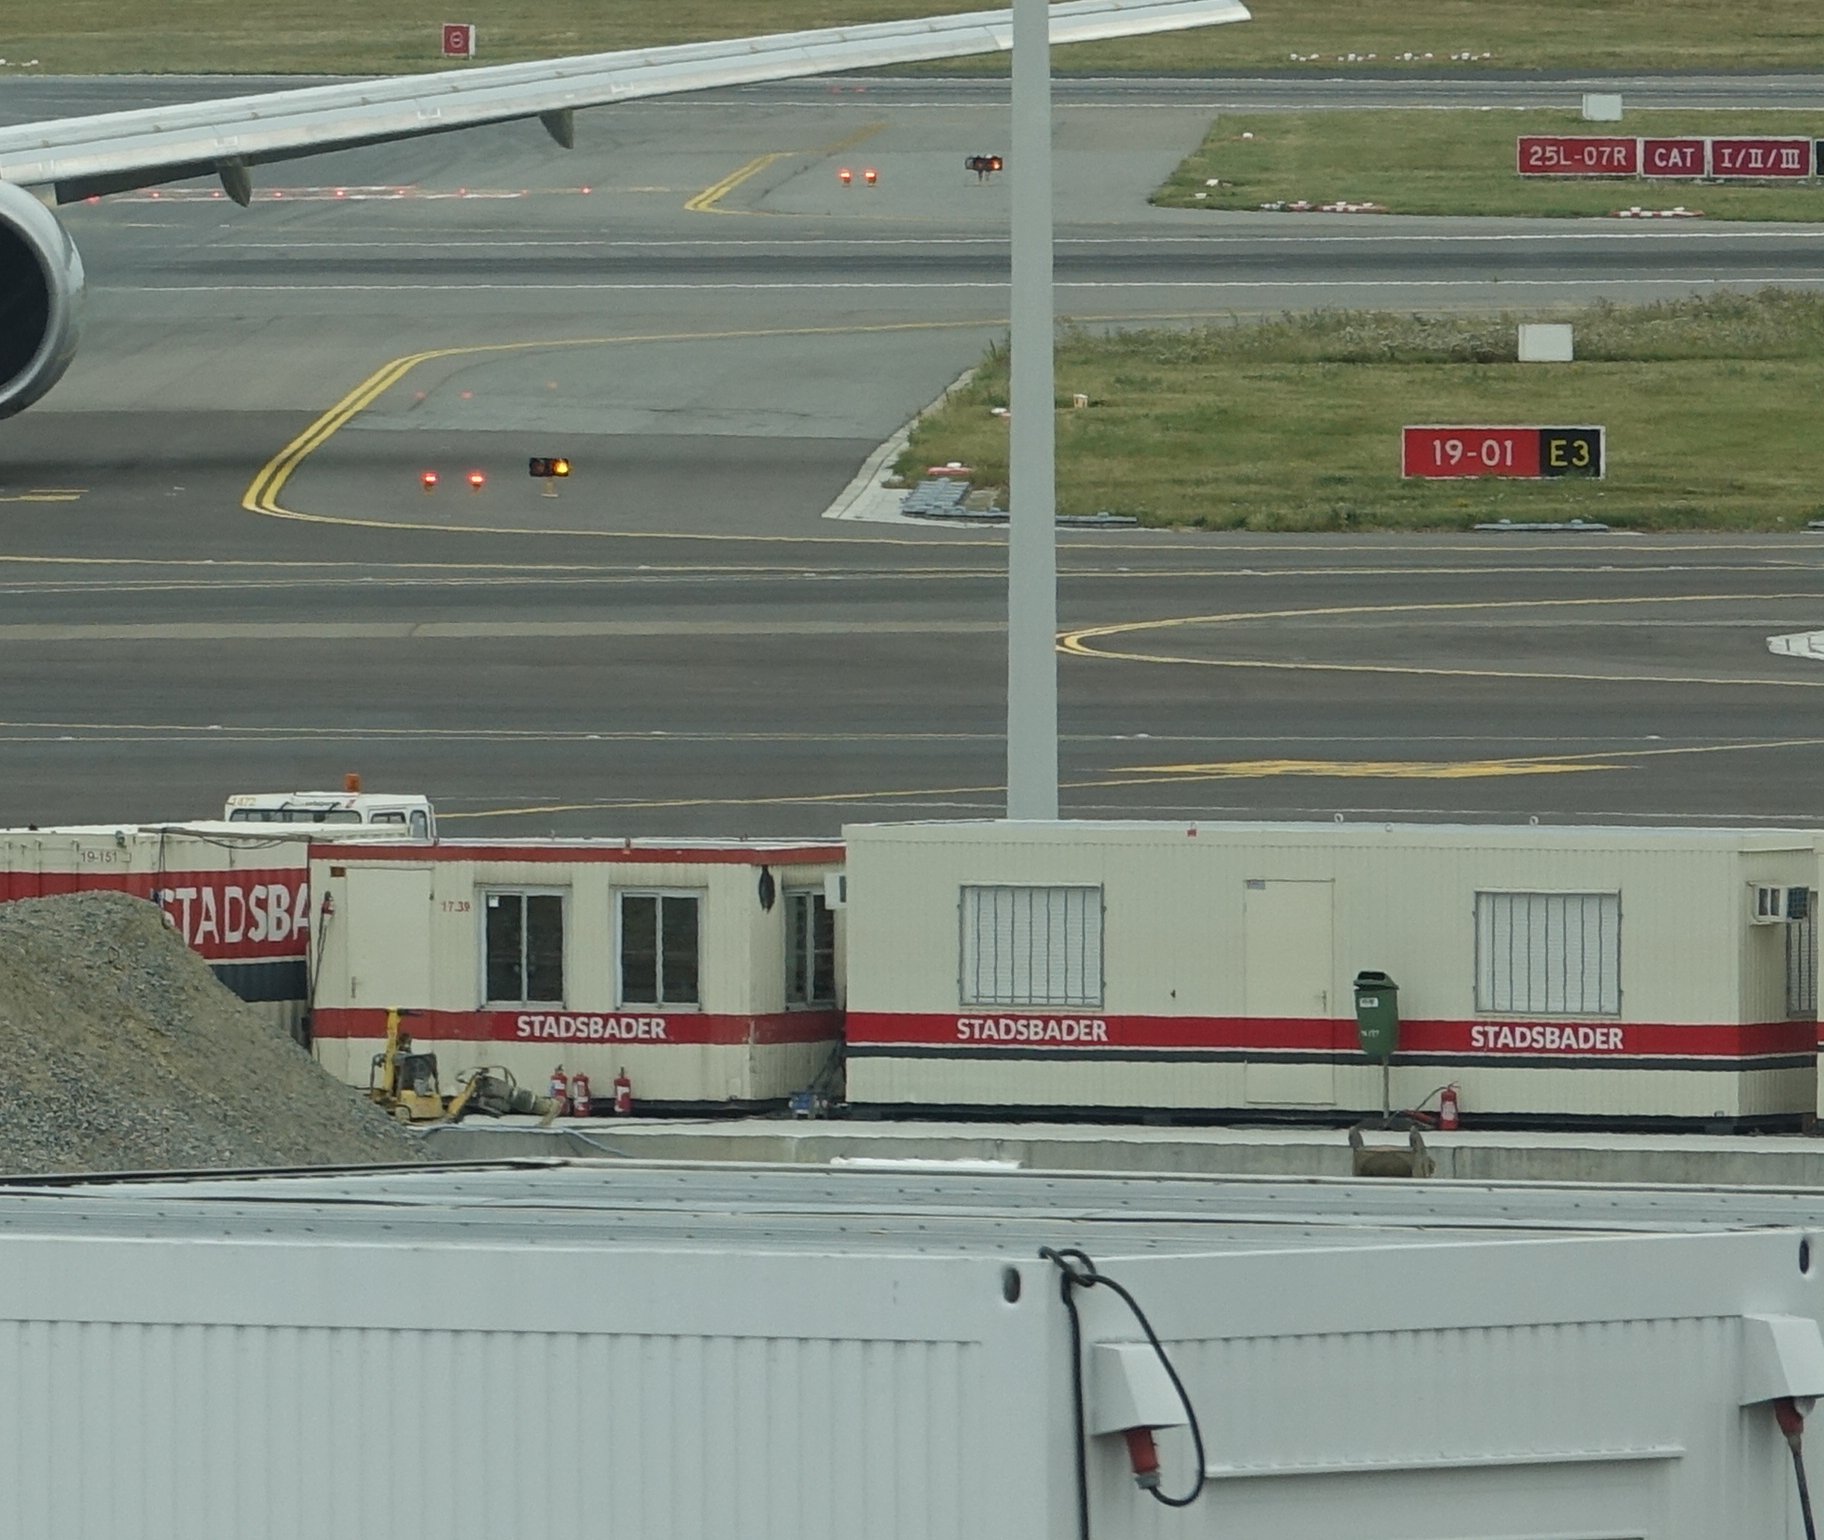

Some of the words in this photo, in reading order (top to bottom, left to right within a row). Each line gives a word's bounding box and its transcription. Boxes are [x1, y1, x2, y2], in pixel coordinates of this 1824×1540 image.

[1529, 146, 1627, 167] 25L-07R
[1654, 148, 1695, 168] CAT
[1432, 439, 1514, 467] 19-01
[1550, 439, 1591, 467] E3
[81, 850, 118, 863] 19-151
[517, 1015, 667, 1039] STADSBADER
[957, 1018, 1108, 1042] STADSBADER
[1471, 1025, 1624, 1050] STADSBADER
